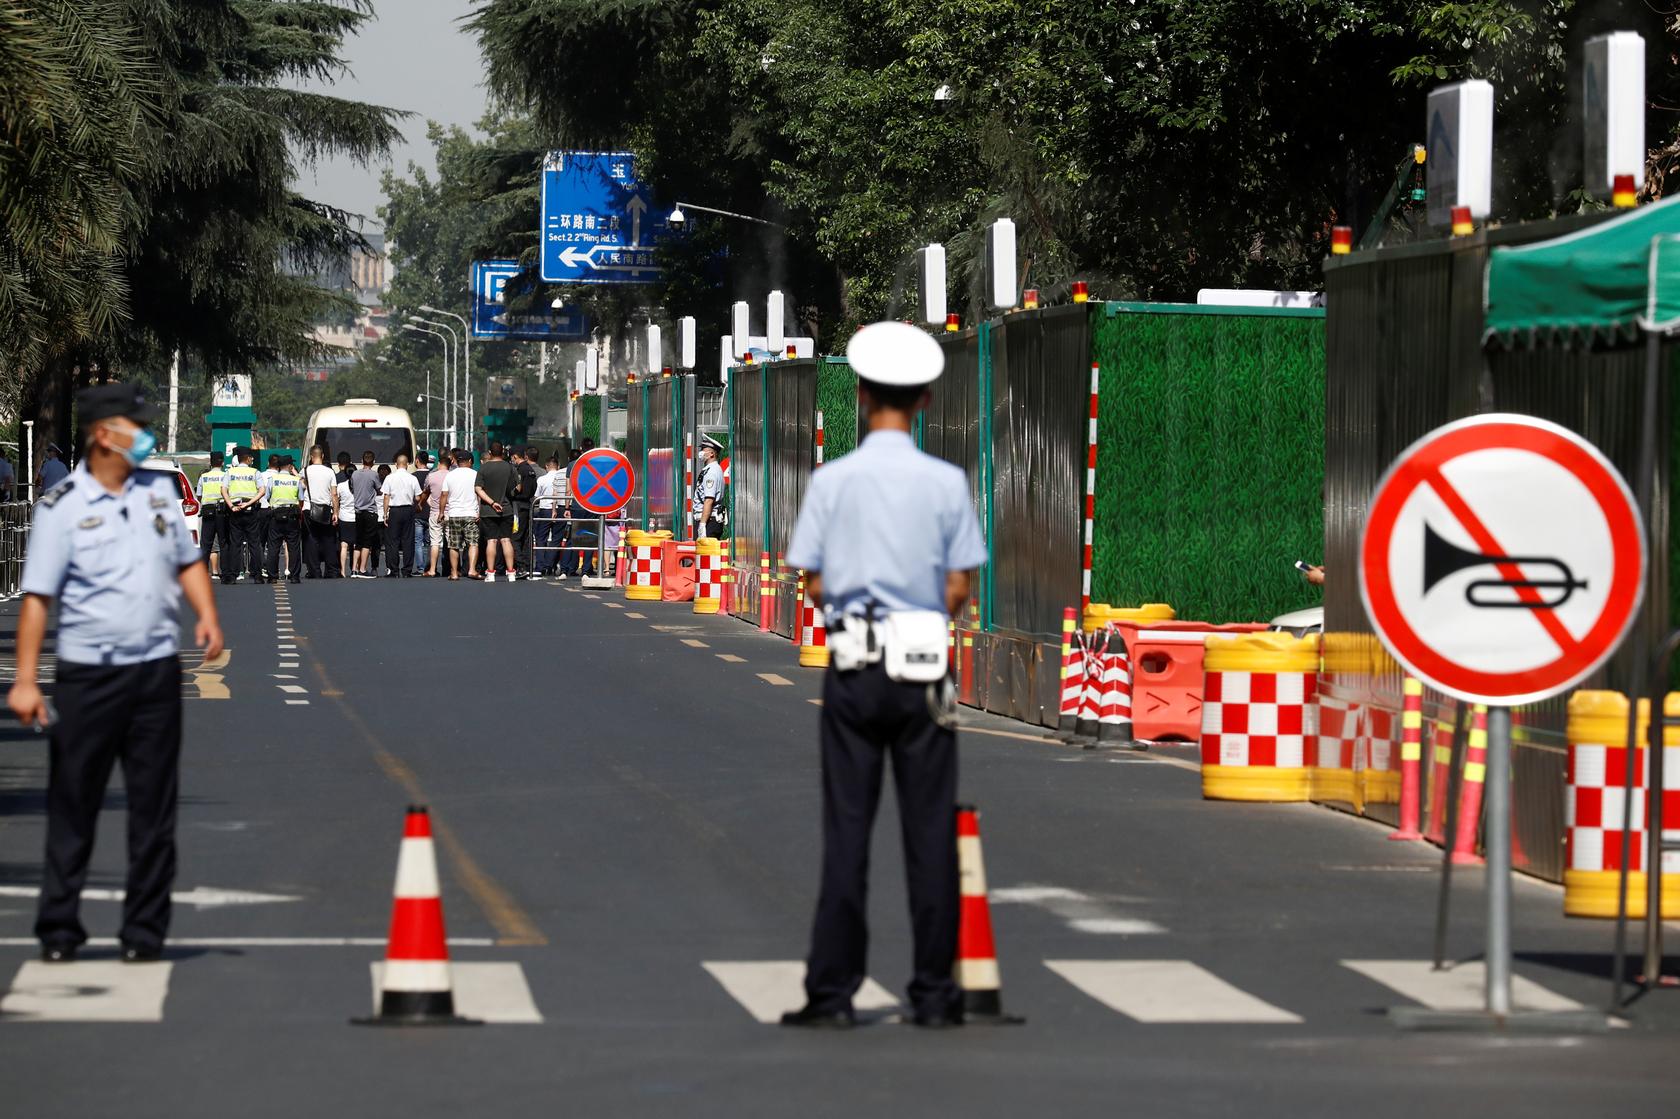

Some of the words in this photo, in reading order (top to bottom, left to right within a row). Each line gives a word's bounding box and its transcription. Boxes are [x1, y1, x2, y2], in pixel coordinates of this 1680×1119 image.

[548, 213, 620, 230] 二环路南二段
